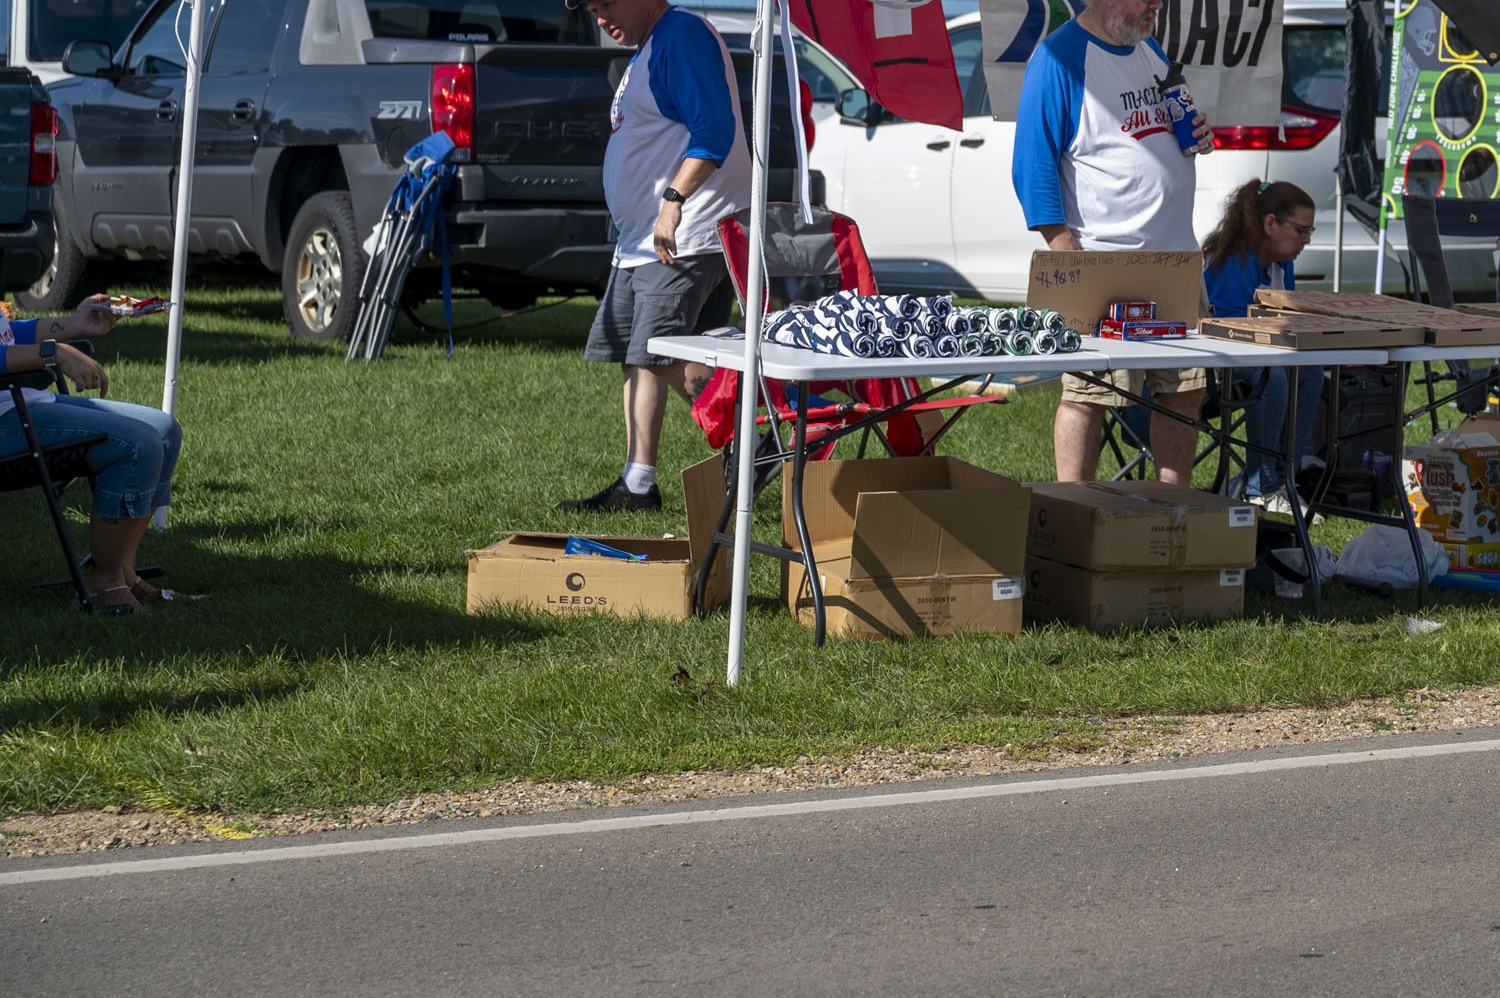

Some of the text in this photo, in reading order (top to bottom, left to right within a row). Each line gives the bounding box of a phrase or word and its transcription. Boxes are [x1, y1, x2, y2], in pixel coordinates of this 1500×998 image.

[448, 32, 490, 42] POLARIS
[1390, 31, 1402, 84] CHALLENGE
[1388, 83, 1398, 108] ZONE
[1039, 253, 1066, 268] Total
[546, 594, 608, 606] LEED'S
